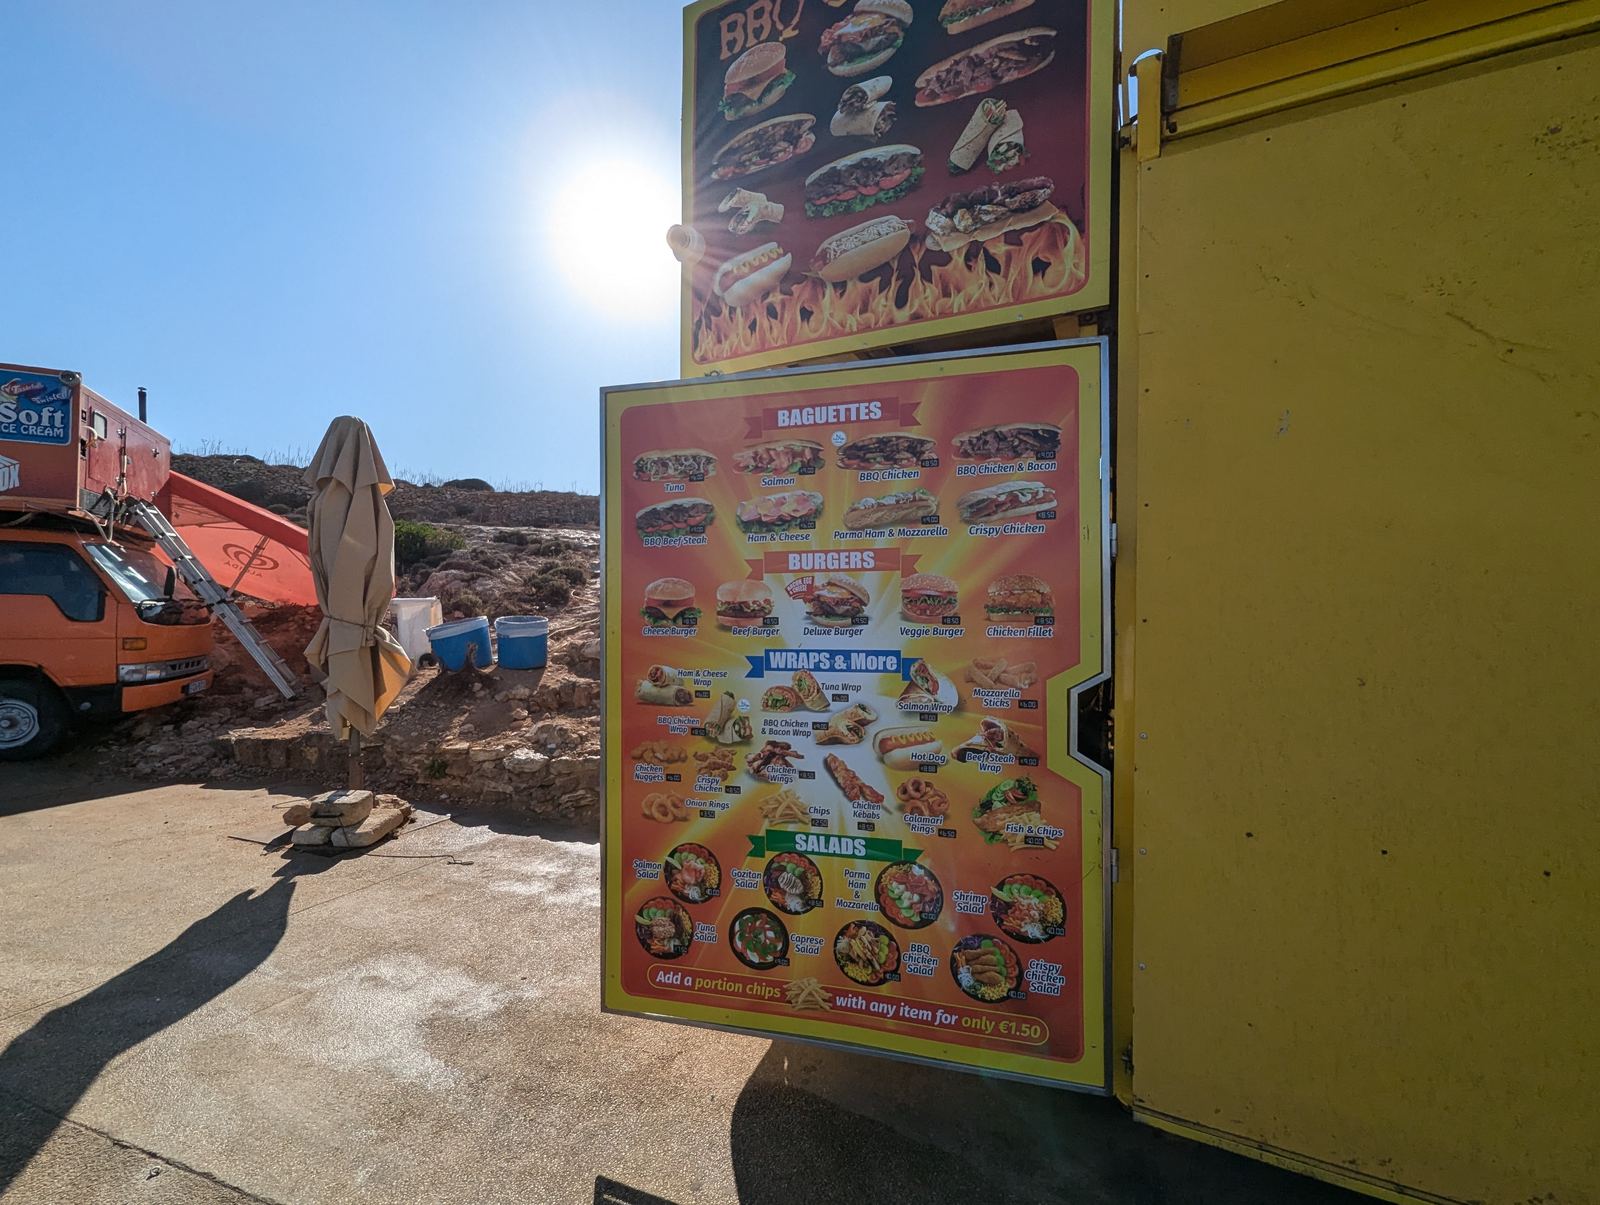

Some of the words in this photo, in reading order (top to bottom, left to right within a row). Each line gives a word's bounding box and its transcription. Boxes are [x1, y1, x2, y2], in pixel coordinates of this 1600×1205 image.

[720, 0, 804, 60] BBQ
[0, 402, 65, 428] Soft
[777, 401, 882, 427] BAGUETTES
[0, 423, 17, 434] CE
[21, 425, 64, 438] CREAM
[957, 466, 976, 476] BBQ
[978, 463, 1014, 474] Chicken
[1017, 463, 1024, 471] &
[1027, 462, 1056, 471] Bacon
[860, 472, 879, 481] BBQ
[881, 470, 919, 480] Chicken
[762, 477, 795, 487] Salmon
[664, 483, 685, 492] Tuna
[834, 530, 863, 540] Parma
[864, 530, 885, 538] Ham
[888, 529, 895, 537] &
[897, 526, 948, 537] Mozzarella
[969, 525, 1001, 537] Crispy
[1003, 524, 1045, 534] Chicken
[644, 537, 661, 546] BBQ
[663, 536, 682, 547] Beef
[684, 536, 708, 545] Steak
[747, 534, 767, 542] Ham
[769, 533, 777, 541] &
[779, 532, 810, 541] Cheese
[788, 551, 875, 570] BURGERS
[642, 627, 670, 636] Cheese
[671, 627, 697, 637] Burger
[732, 627, 751, 637] Beef
[752, 627, 780, 637] Burger
[803, 627, 832, 636] Deluxe
[833, 627, 864, 638] Burger
[900, 627, 930, 638] Veggie
[932, 627, 965, 638] Burger
[987, 626, 1025, 637] Chicken
[1027, 627, 1053, 637] Fillet
[769, 651, 830, 670] WRAPS
[834, 654, 847, 670] &
[851, 652, 897, 671] More
[702, 669, 728, 678] Cheese
[693, 679, 712, 687] Wrap
[821, 683, 840, 691] Tuna
[841, 683, 862, 692] Wrap
[973, 688, 1020, 698] Mozzarella
[898, 702, 929, 711] Salmon
[931, 703, 953, 713] Wrap
[983, 698, 1010, 707] Sticks
[657, 717, 673, 725] BBQ
[673, 717, 700, 725] Chicken
[763, 719, 779, 728] BBQ
[780, 719, 809, 728] Chicken
[670, 726, 688, 736] Wrap
[761, 727, 767, 735] &
[768, 728, 791, 736] Bacon
[792, 729, 812, 738] Wrap
[911, 753, 927, 761] Hot
[928, 753, 946, 764] Dog
[966, 753, 988, 763] Beef
[989, 754, 1014, 763] Steak
[635, 765, 663, 773] Chicken
[766, 766, 797, 774] Chicken
[979, 763, 1002, 773] Wrap
[634, 773, 664, 781] Nuggets
[697, 776, 720, 785] Crispy
[769, 775, 794, 784] Wings
[694, 784, 723, 793] Chicken
[685, 799, 707, 807] Onion
[708, 800, 730, 810] Rings
[852, 801, 881, 810] Chicken
[808, 806, 831, 816] Chips
[853, 810, 881, 819] Kebabs
[903, 814, 944, 825] Calamari
[910, 823, 935, 834] Rings
[1005, 824, 1024, 834] Fish
[1026, 826, 1034, 834] &
[1037, 826, 1064, 837] Chips
[795, 833, 866, 856] SALADS
[633, 860, 662, 869] Salmon
[637, 870, 659, 879] Salad
[731, 869, 762, 879] Gozitan
[844, 869, 870, 880] Parma
[735, 879, 758, 889] Salad
[848, 880, 866, 889] Ham
[854, 890, 860, 899] &
[953, 891, 988, 904] Shrimp
[836, 899, 880, 911] Mozzarella
[956, 902, 984, 914] Salad
[696, 923, 716, 931] Tuna
[694, 932, 717, 942] Salad
[790, 934, 824, 946] Caprese
[795, 944, 819, 954] Salad
[911, 944, 930, 954] BBQ
[902, 954, 938, 966] Chicken
[907, 965, 934, 975] Salad
[1029, 960, 1061, 973] Crispy
[1025, 971, 1065, 984] Chicken
[1030, 982, 1060, 994] Salad
[656, 970, 681, 985] Add
[684, 977, 692, 986] a
[695, 977, 742, 993] portion
[746, 982, 781, 1000] chips
[836, 995, 866, 1010] with
[869, 1001, 896, 1017] any
[900, 1003, 932, 1021] item
[934, 1009, 959, 1026] for
[961, 1015, 996, 1034] only
[999, 1020, 1041, 1038] €1.50
